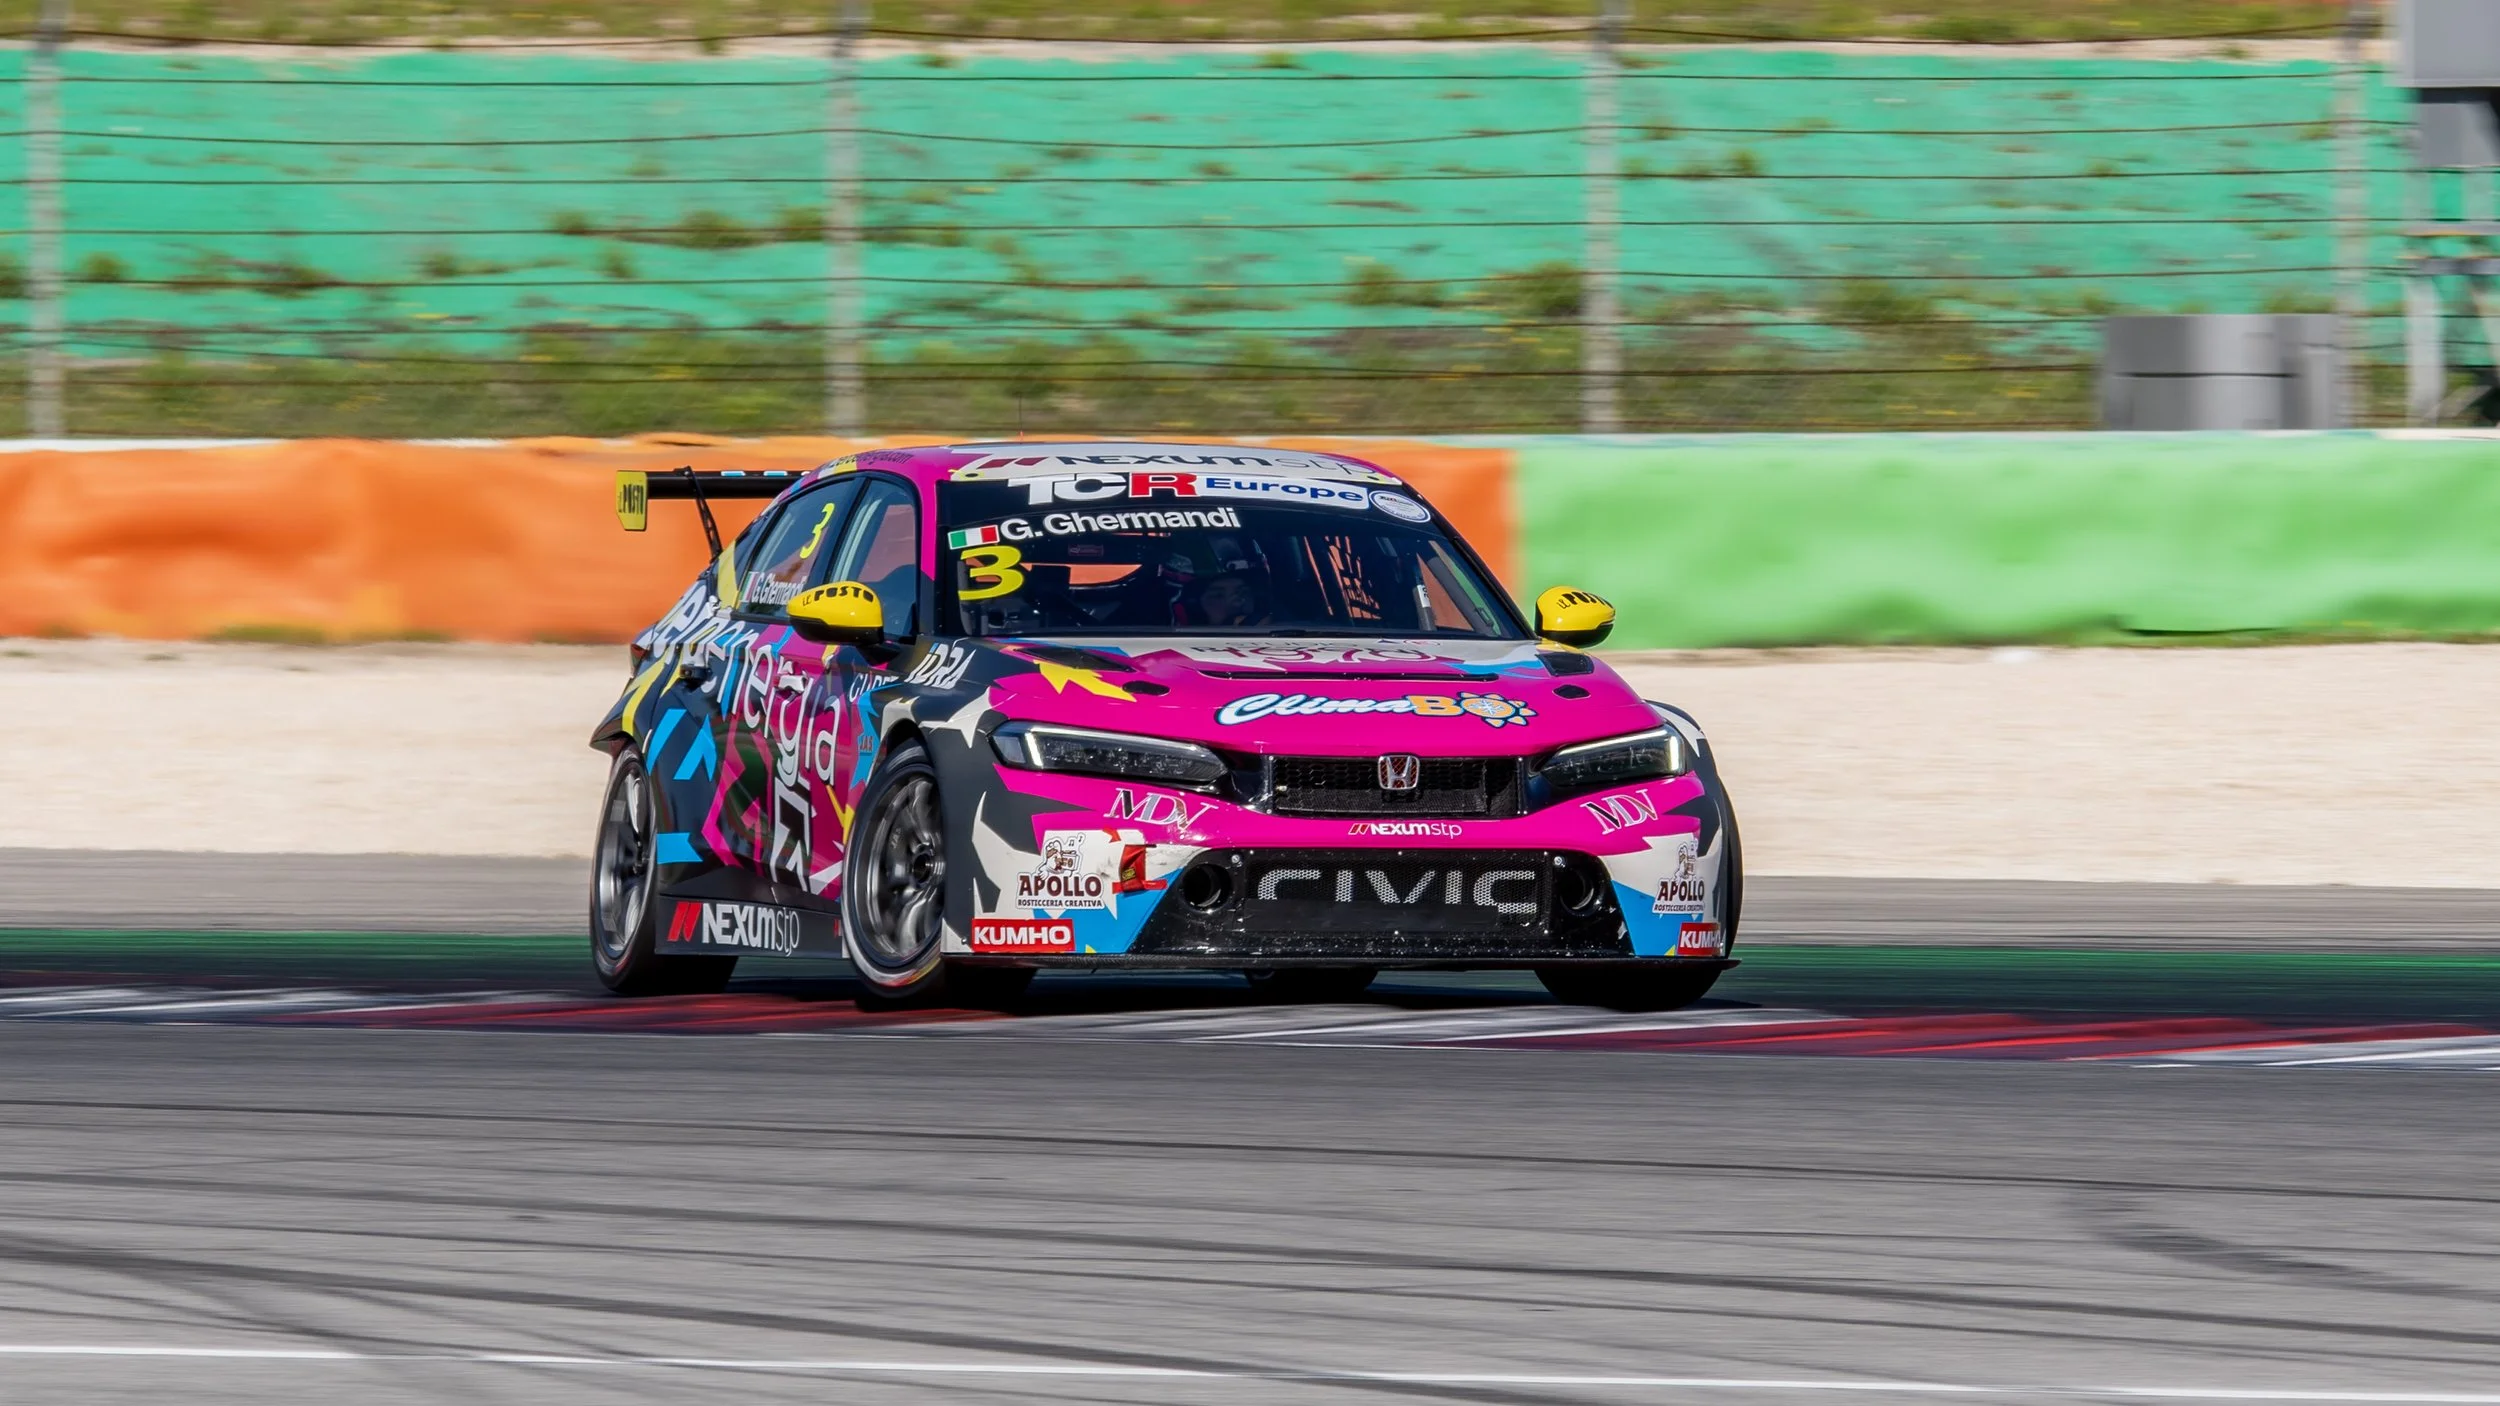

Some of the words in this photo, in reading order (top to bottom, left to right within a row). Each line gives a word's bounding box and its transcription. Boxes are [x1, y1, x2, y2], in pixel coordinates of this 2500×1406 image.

[1008, 472, 1199, 505] TCR
[1206, 478, 1364, 502] Europe
[799, 503, 835, 560] 3
[958, 545, 1023, 600] 3
[814, 586, 874, 602] POSTO
[1103, 787, 1219, 831] MDV
[1580, 789, 1658, 835] MDV
[1018, 875, 1102, 897] APOLLO
[1257, 869, 1537, 914] CIVIC
[1657, 880, 1705, 901] APOLLO
[1018, 899, 1063, 907] ROSTICCERIA
[1064, 899, 1102, 907] CREATIVA
[973, 926, 1071, 945] KUMHO
